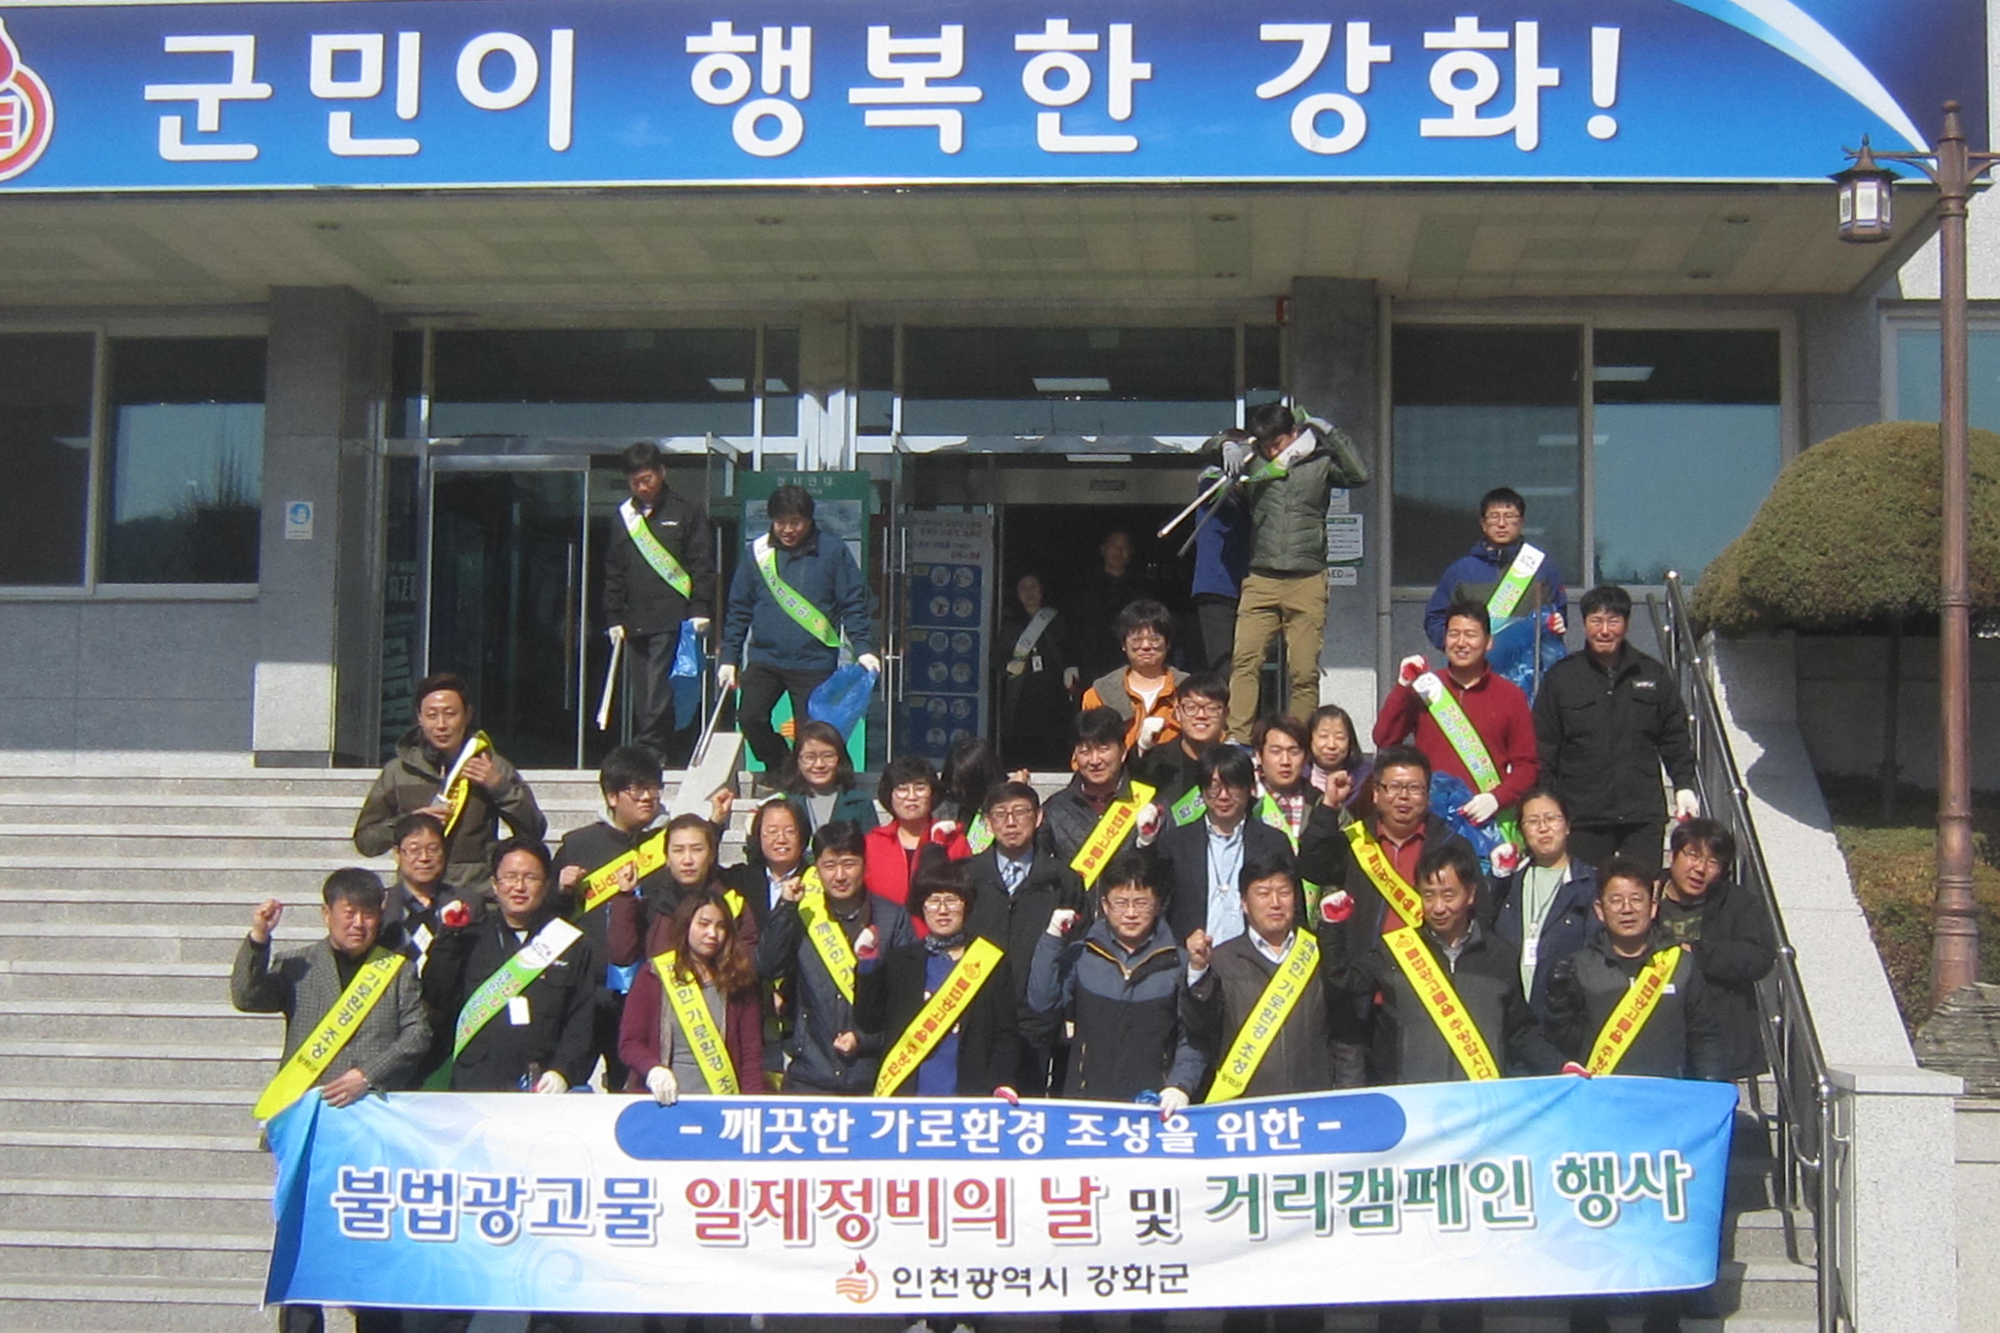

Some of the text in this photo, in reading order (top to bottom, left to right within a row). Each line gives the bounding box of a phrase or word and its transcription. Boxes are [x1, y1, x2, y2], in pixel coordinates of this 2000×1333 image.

[143, 16, 1620, 162] 군민이 행복한 강화!
[1253, 979, 1296, 1040] 가로환경
[311, 1026, 341, 1060] 조성
[1232, 1040, 1257, 1076] 조성
[1448, 1017, 1493, 1080] 추방합시다
[719, 1106, 857, 1155] 깨끗한
[869, 1104, 1047, 1156] 가로환경
[1065, 1108, 1198, 1154] 조성을
[1215, 1106, 1304, 1153] 위한
[334, 1152, 1691, 1243] 불법광고물 일제정비의 날 및 거리캠페인 행사
[893, 1264, 1190, 1300] 인천광역시 강화군
